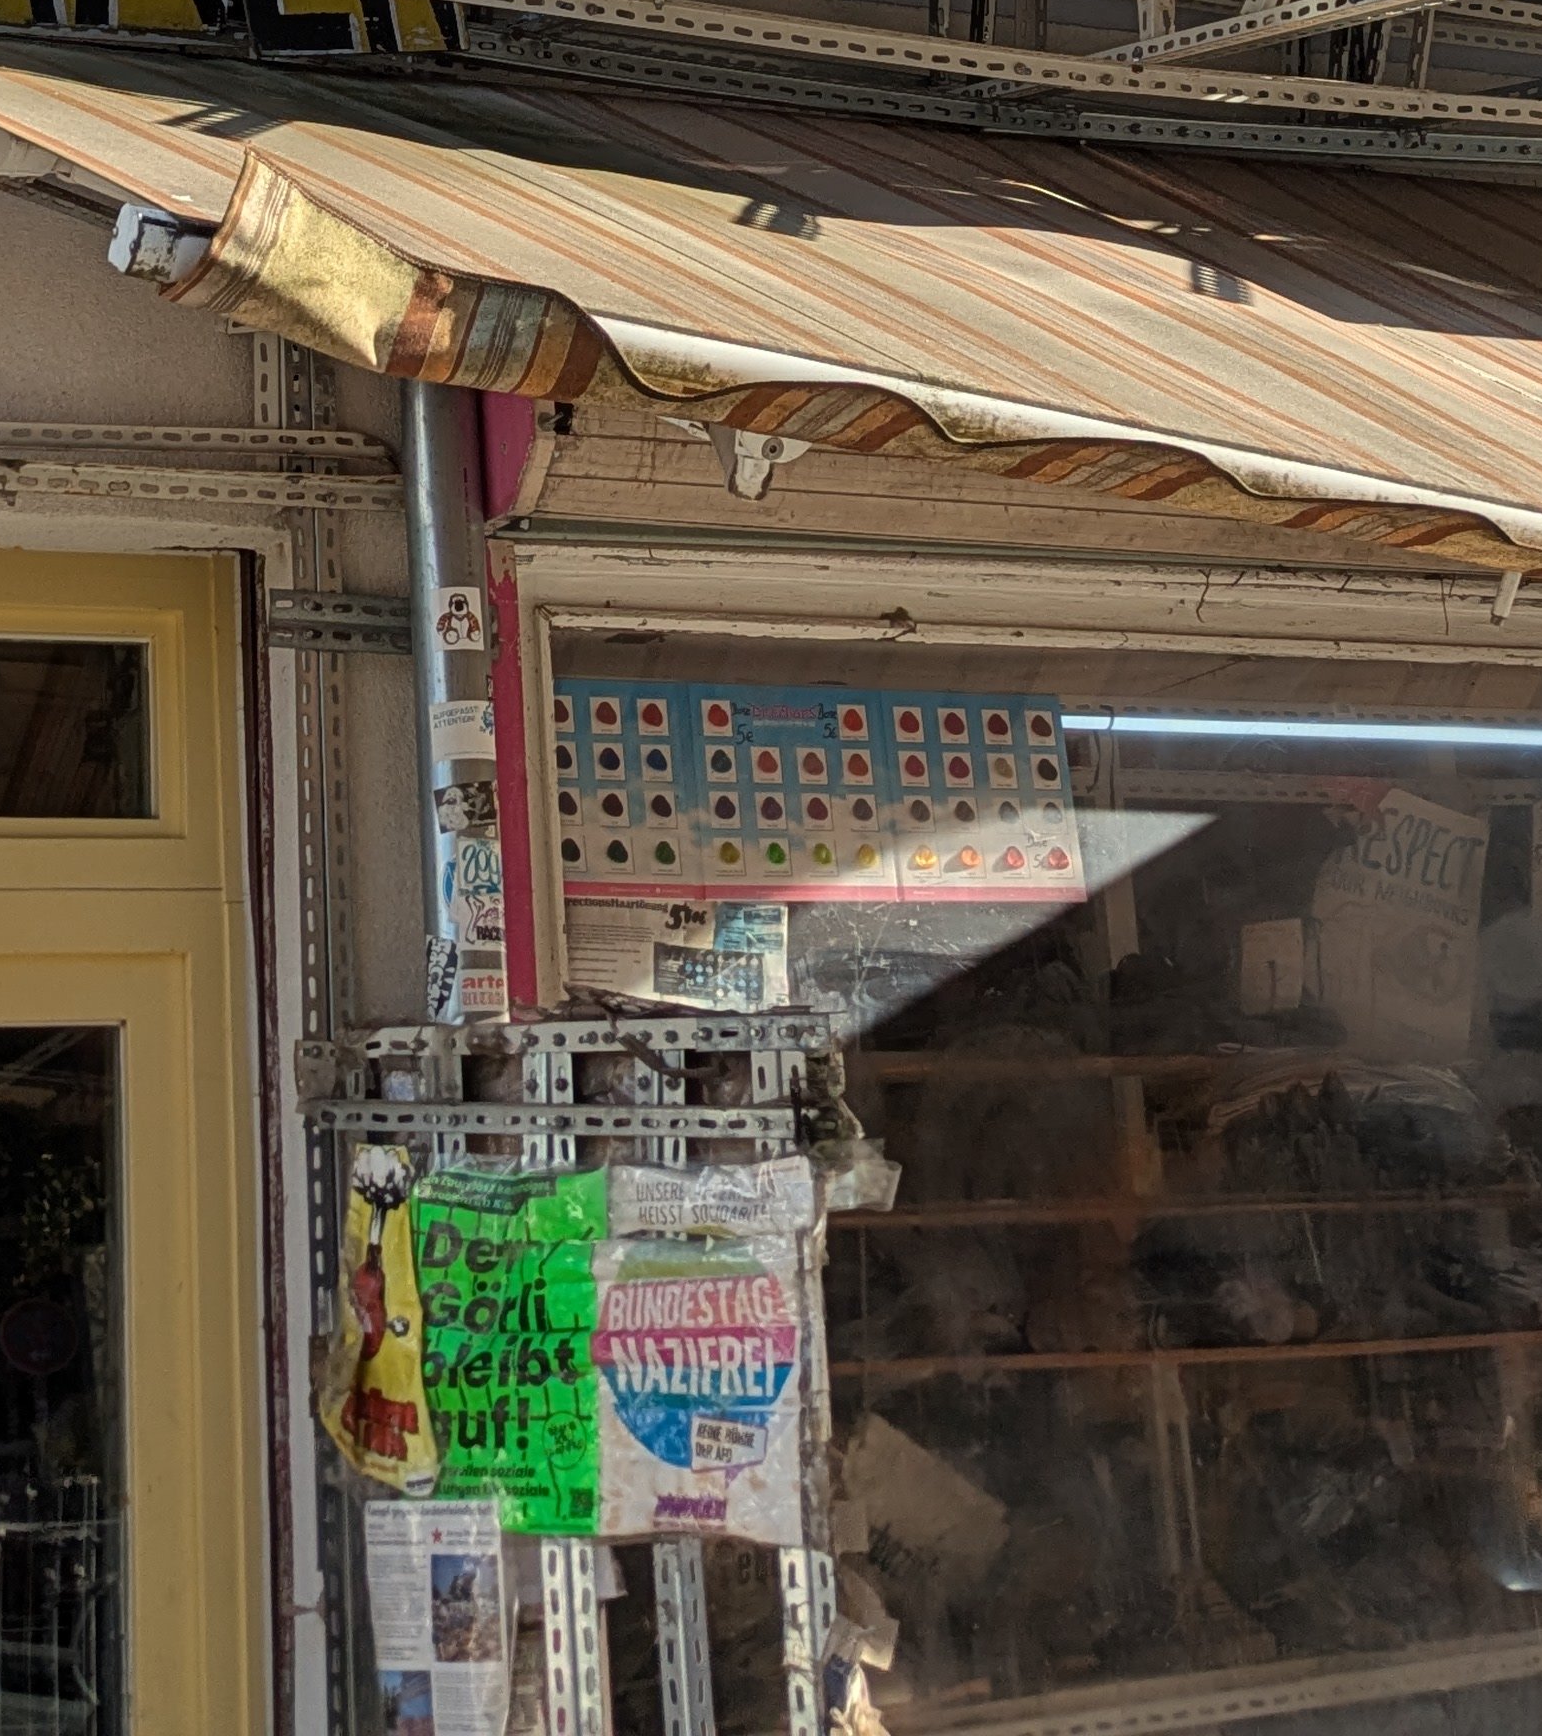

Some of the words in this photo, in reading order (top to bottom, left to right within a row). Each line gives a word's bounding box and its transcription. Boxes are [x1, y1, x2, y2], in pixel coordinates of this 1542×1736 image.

[421, 1219, 536, 1274] Der
[422, 1277, 547, 1334] Görli
[608, 1276, 775, 1333] BUNDESTAG
[422, 1335, 577, 1388] bleibt
[610, 1335, 776, 1398] NAZIFREI
